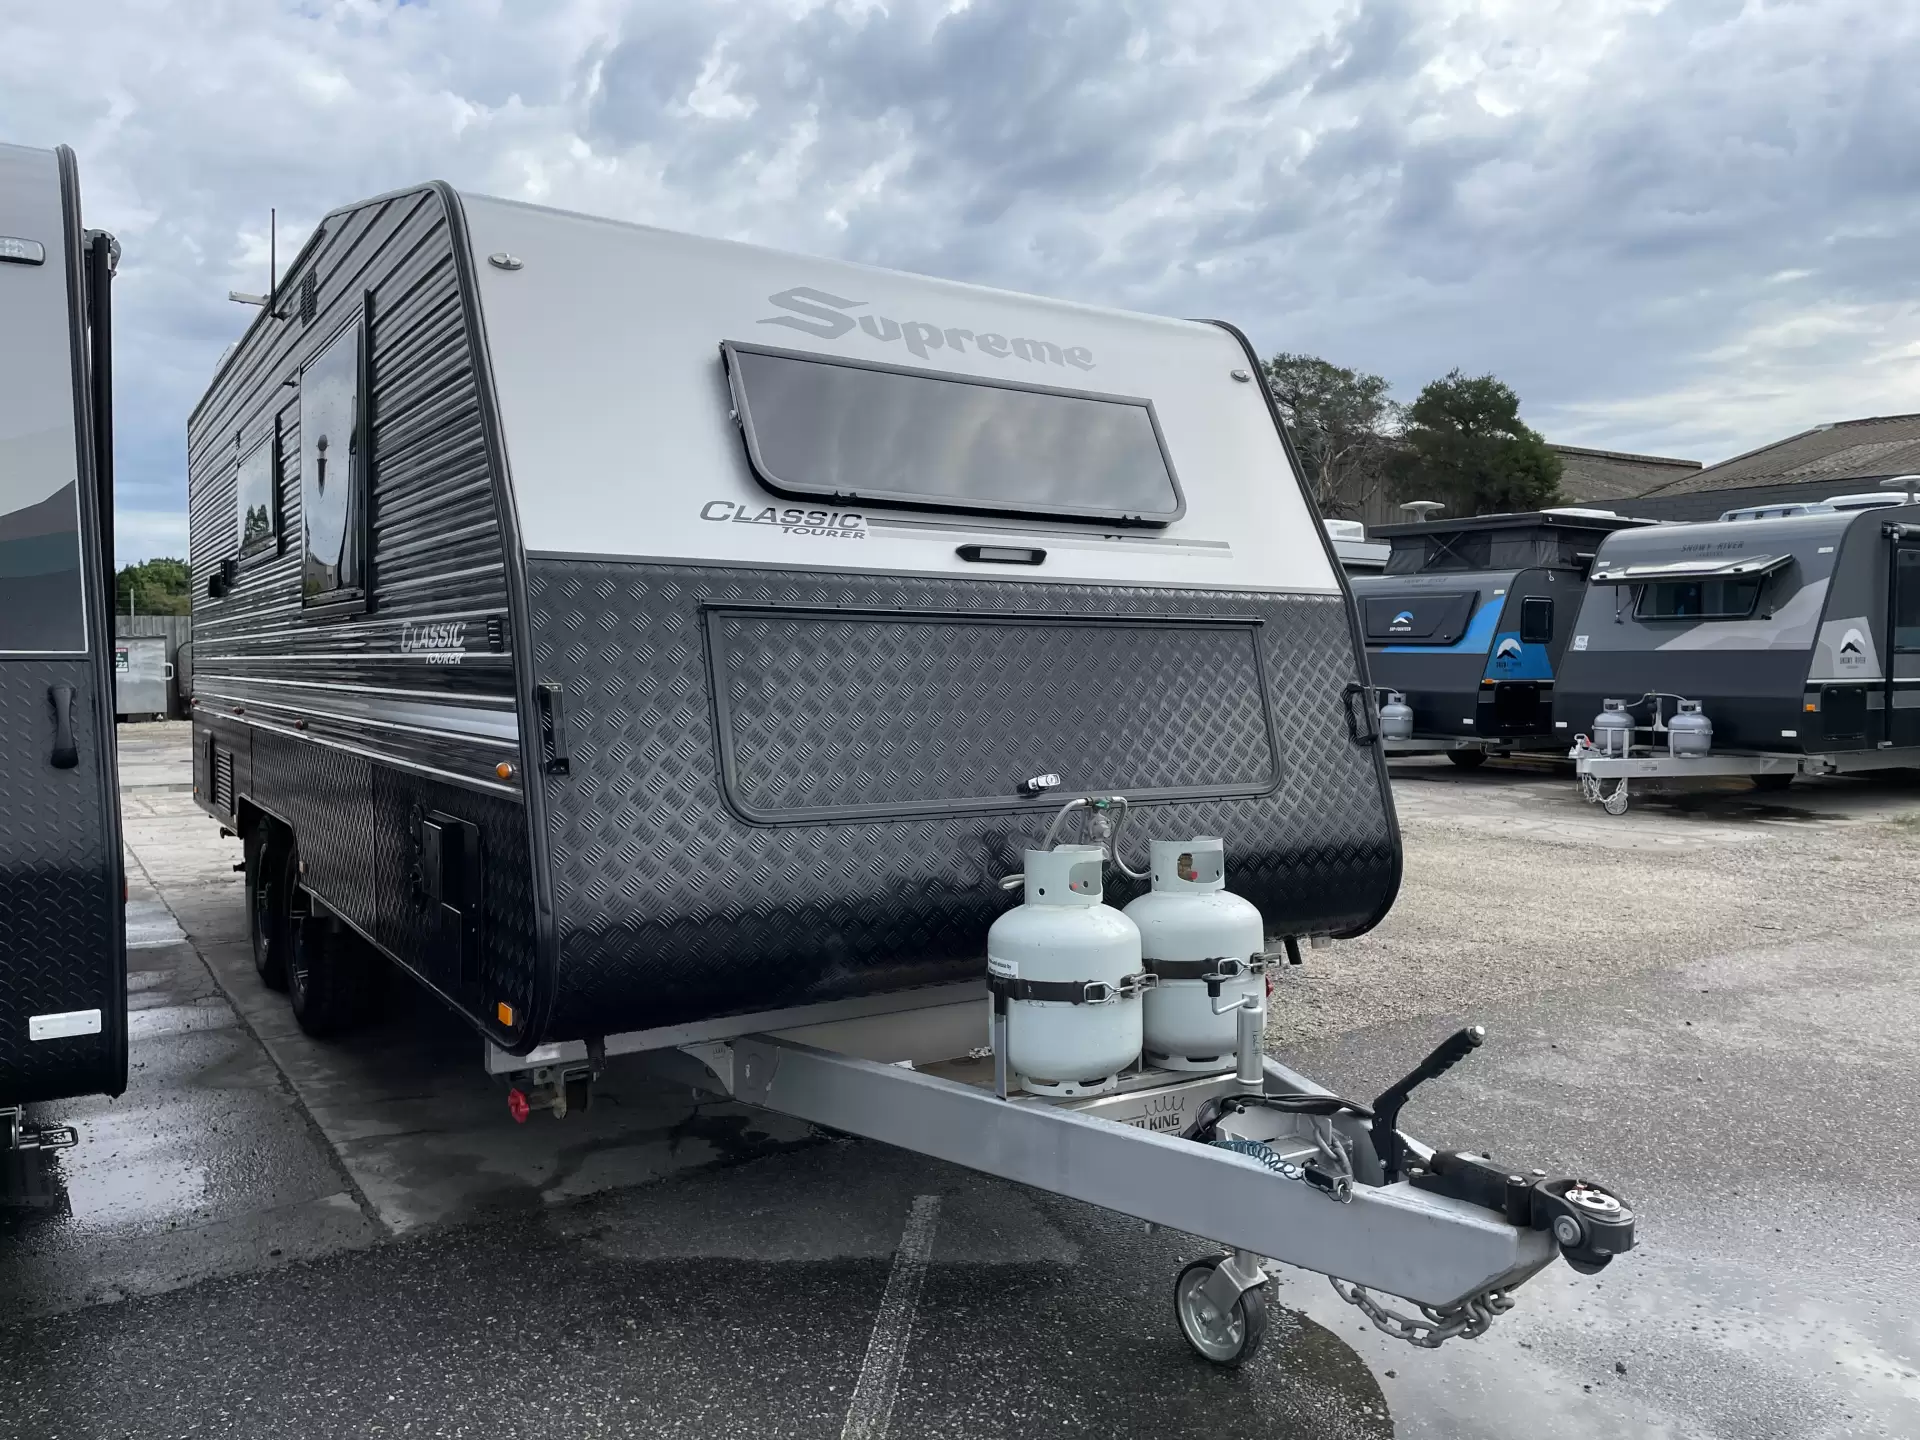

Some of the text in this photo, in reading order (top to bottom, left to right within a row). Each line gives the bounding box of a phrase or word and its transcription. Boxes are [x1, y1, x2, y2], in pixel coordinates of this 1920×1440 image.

[756, 286, 1096, 372] Supreme
[700, 500, 863, 529] CLASSIC
[782, 526, 866, 540] TOURER
[400, 621, 467, 653] CLASSIC
[425, 652, 464, 665] TOURER
[1149, 1113, 1180, 1131] KING
